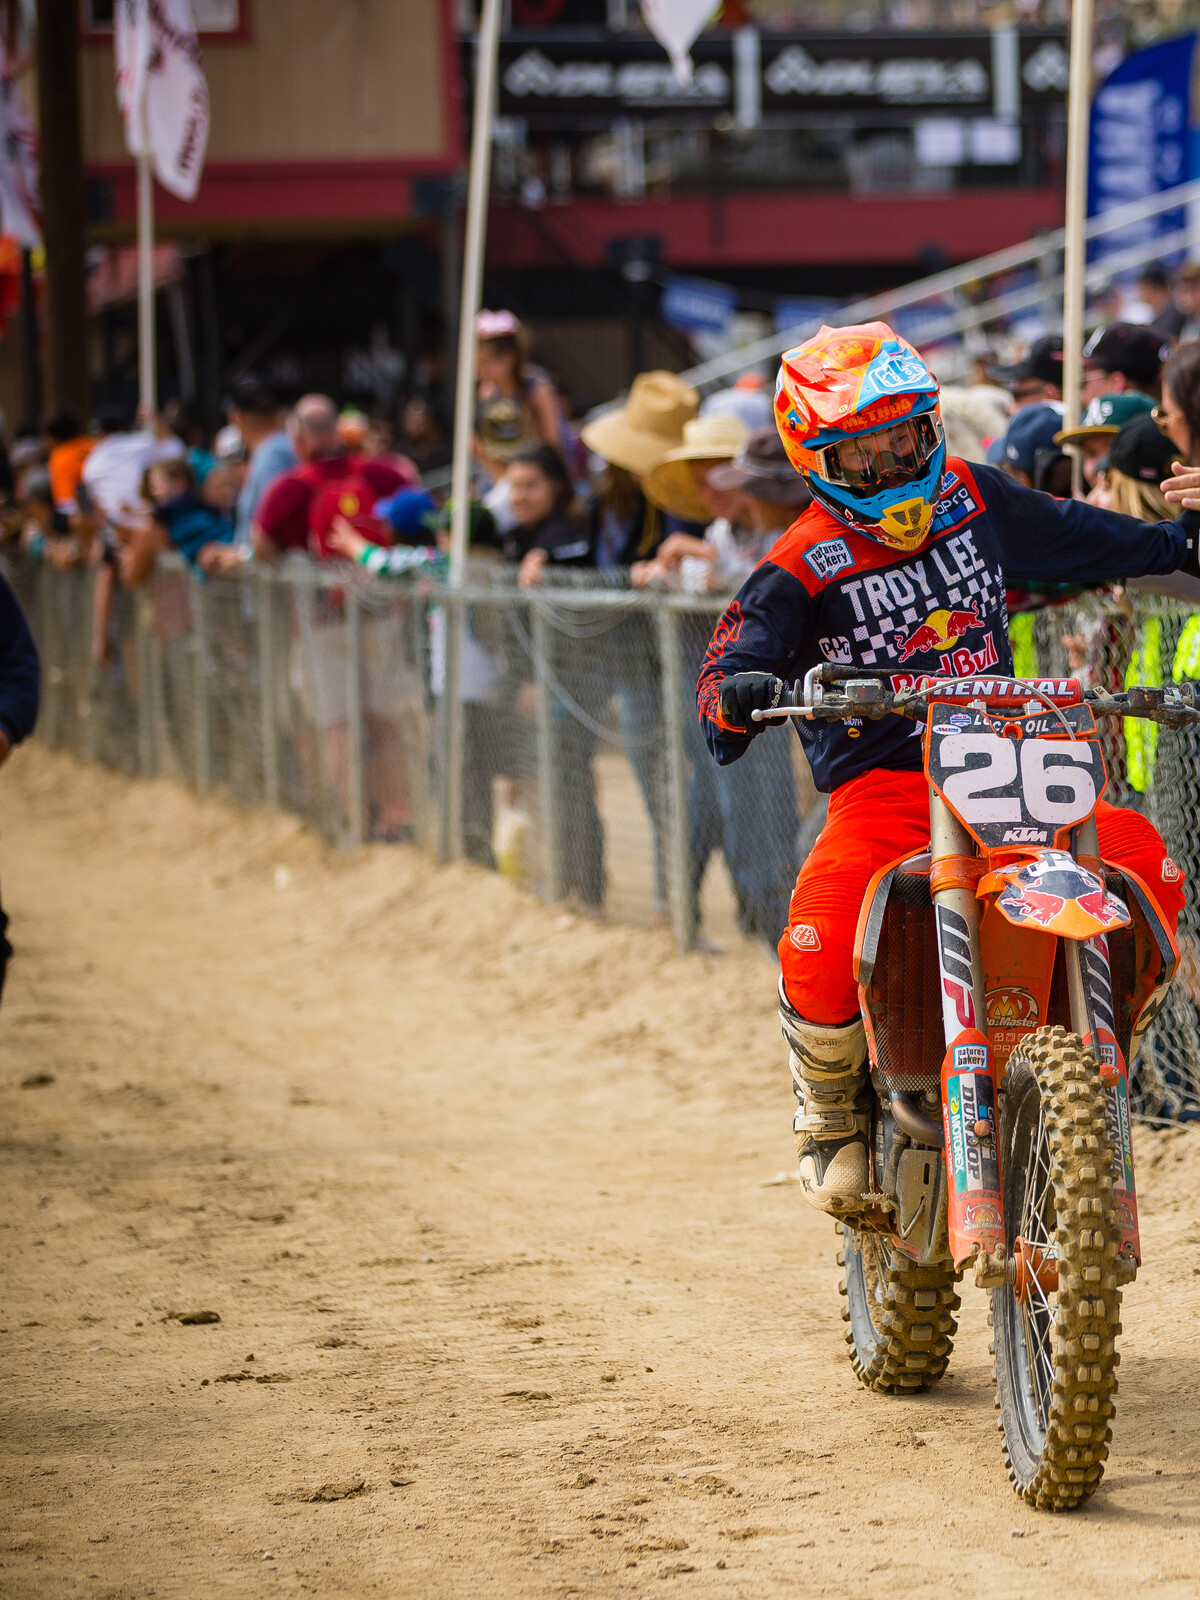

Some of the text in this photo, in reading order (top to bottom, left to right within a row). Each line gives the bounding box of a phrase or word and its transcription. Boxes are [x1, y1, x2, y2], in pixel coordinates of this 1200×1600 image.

[936, 487, 969, 515] oPro
[840, 560, 932, 623] TROY
[929, 528, 986, 587] LEE
[952, 631, 999, 679] Bull
[931, 679, 1078, 698] RENTHAL
[1025, 720, 1050, 733] OIL
[939, 732, 1097, 825] 26
[1002, 827, 1049, 843] KTM
[957, 1055, 985, 1066] bakery
[951, 1113, 965, 1175] MOTOREX
[961, 1084, 981, 1180] DUNLOP
[1119, 1095, 1131, 1154] MOTOREX
